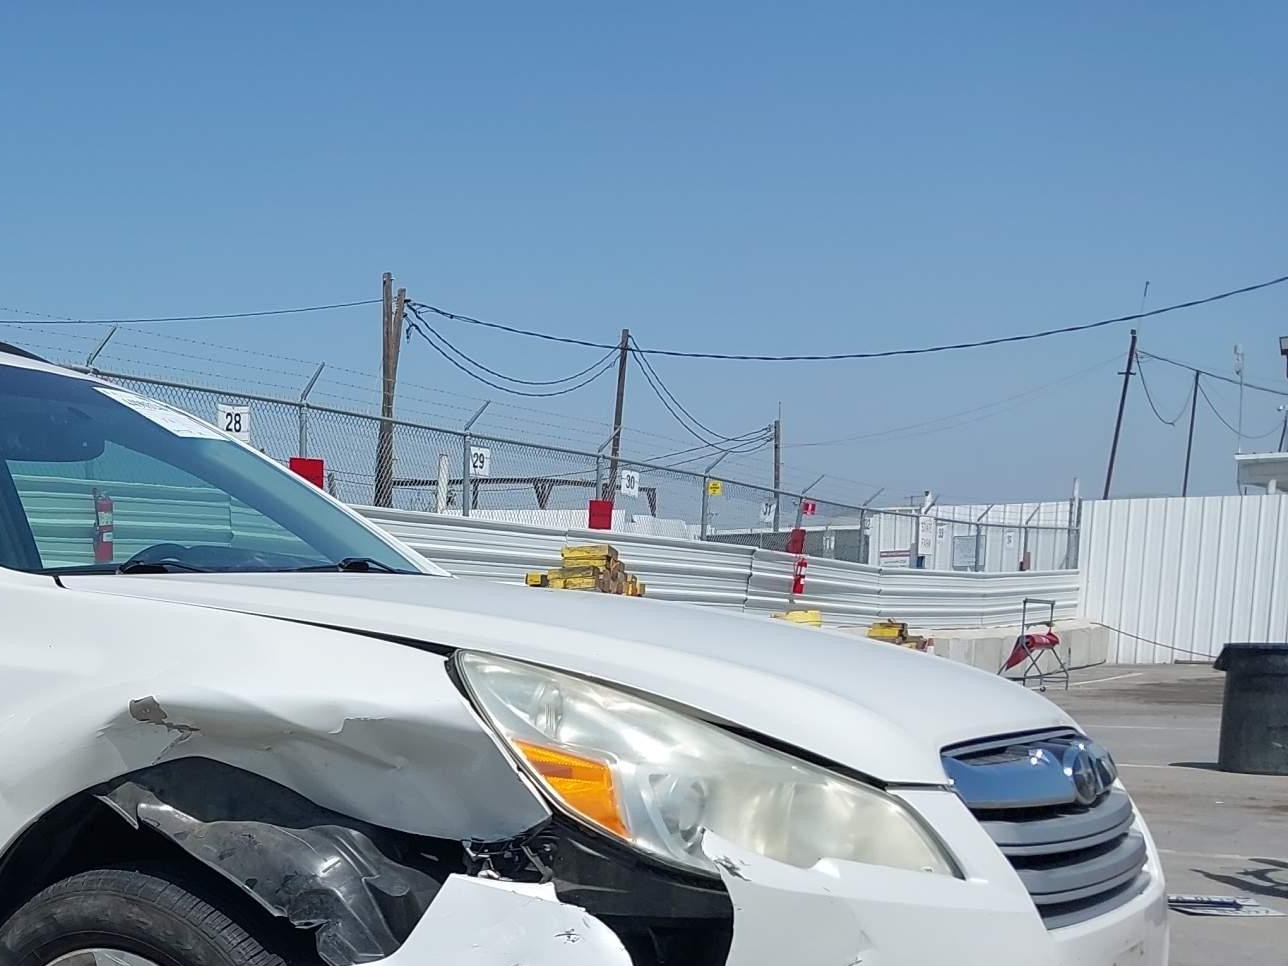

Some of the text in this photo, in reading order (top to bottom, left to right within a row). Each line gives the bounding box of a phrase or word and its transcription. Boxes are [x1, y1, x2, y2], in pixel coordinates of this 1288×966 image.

[225, 412, 242, 433] 28
[472, 452, 485, 470] 29
[625, 474, 635, 490] 30
